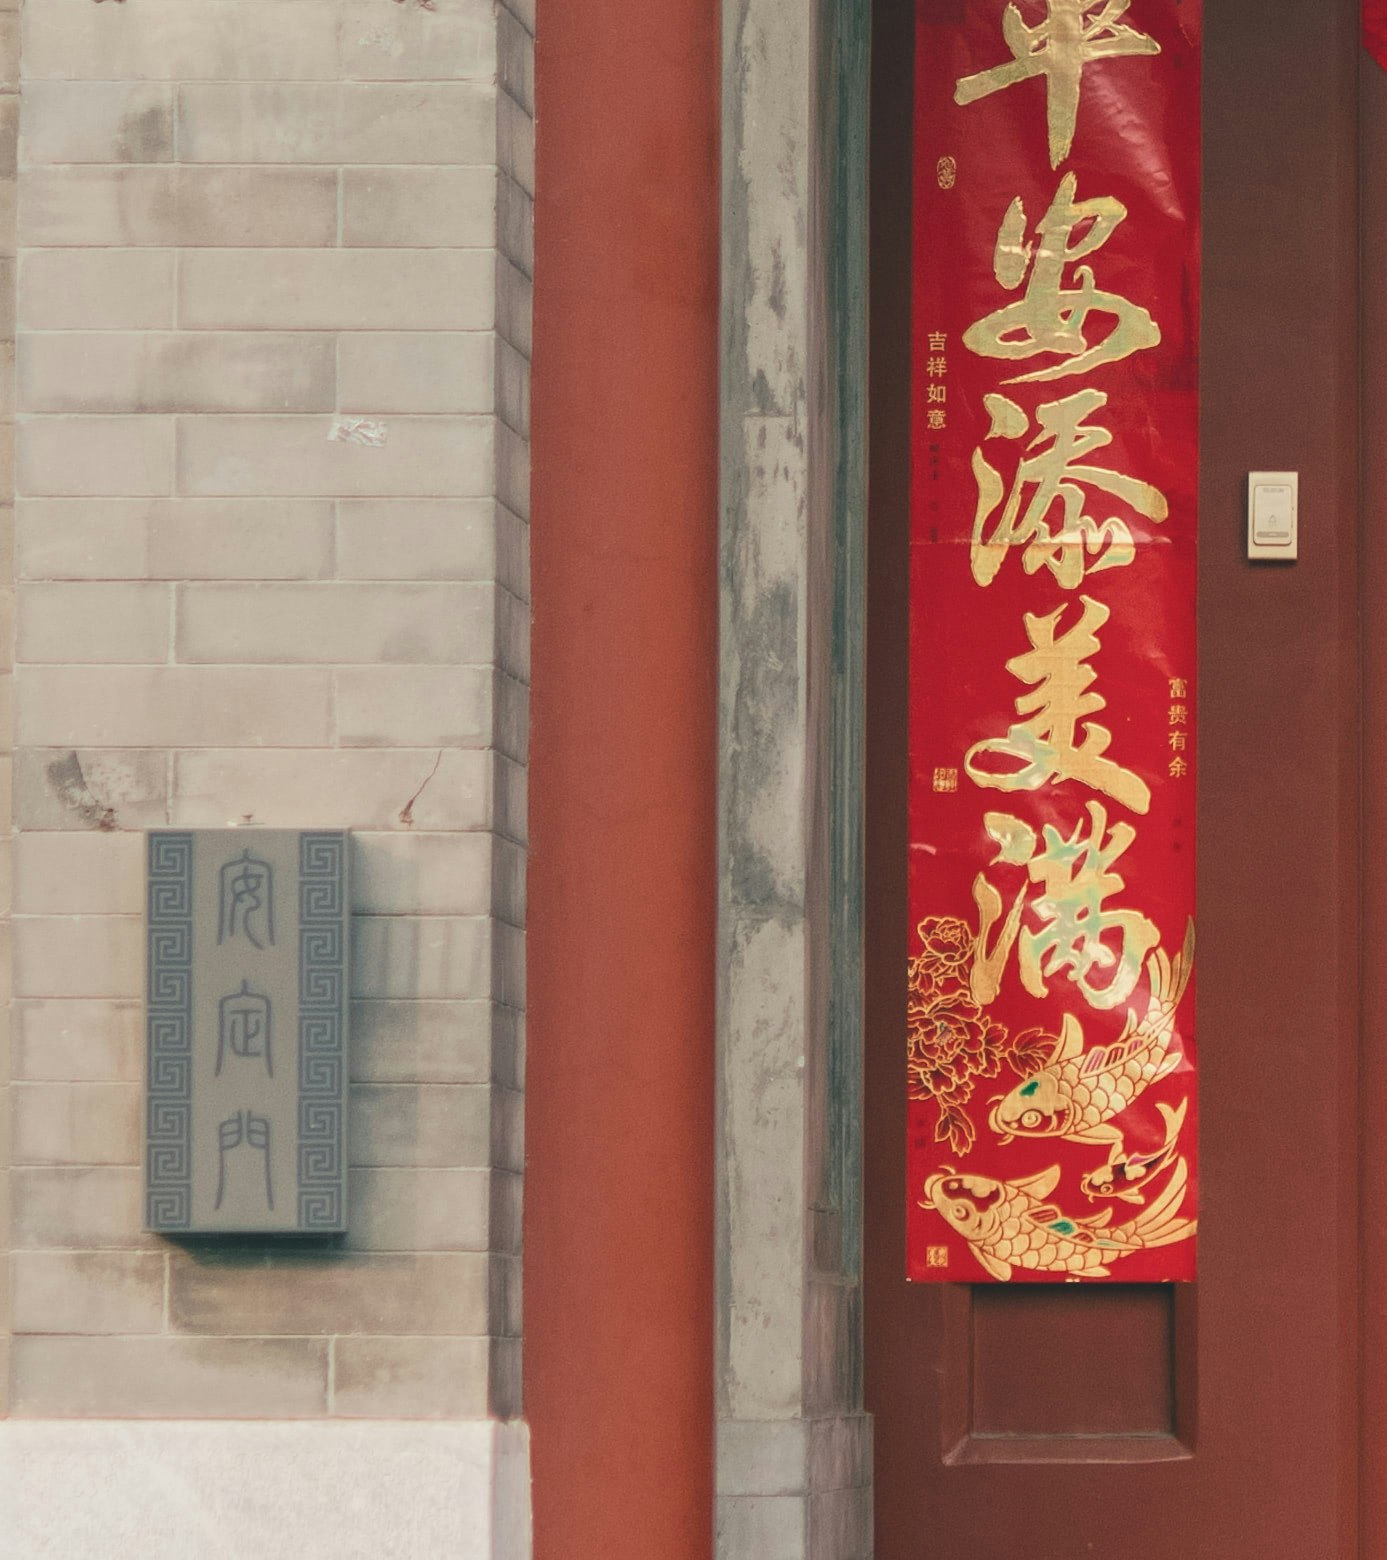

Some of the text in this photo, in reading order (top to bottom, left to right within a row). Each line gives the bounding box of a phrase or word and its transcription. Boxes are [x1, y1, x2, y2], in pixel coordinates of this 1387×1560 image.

[926, 330, 948, 430] 吉祥如意
[1168, 678, 1189, 778] 富贵有余
